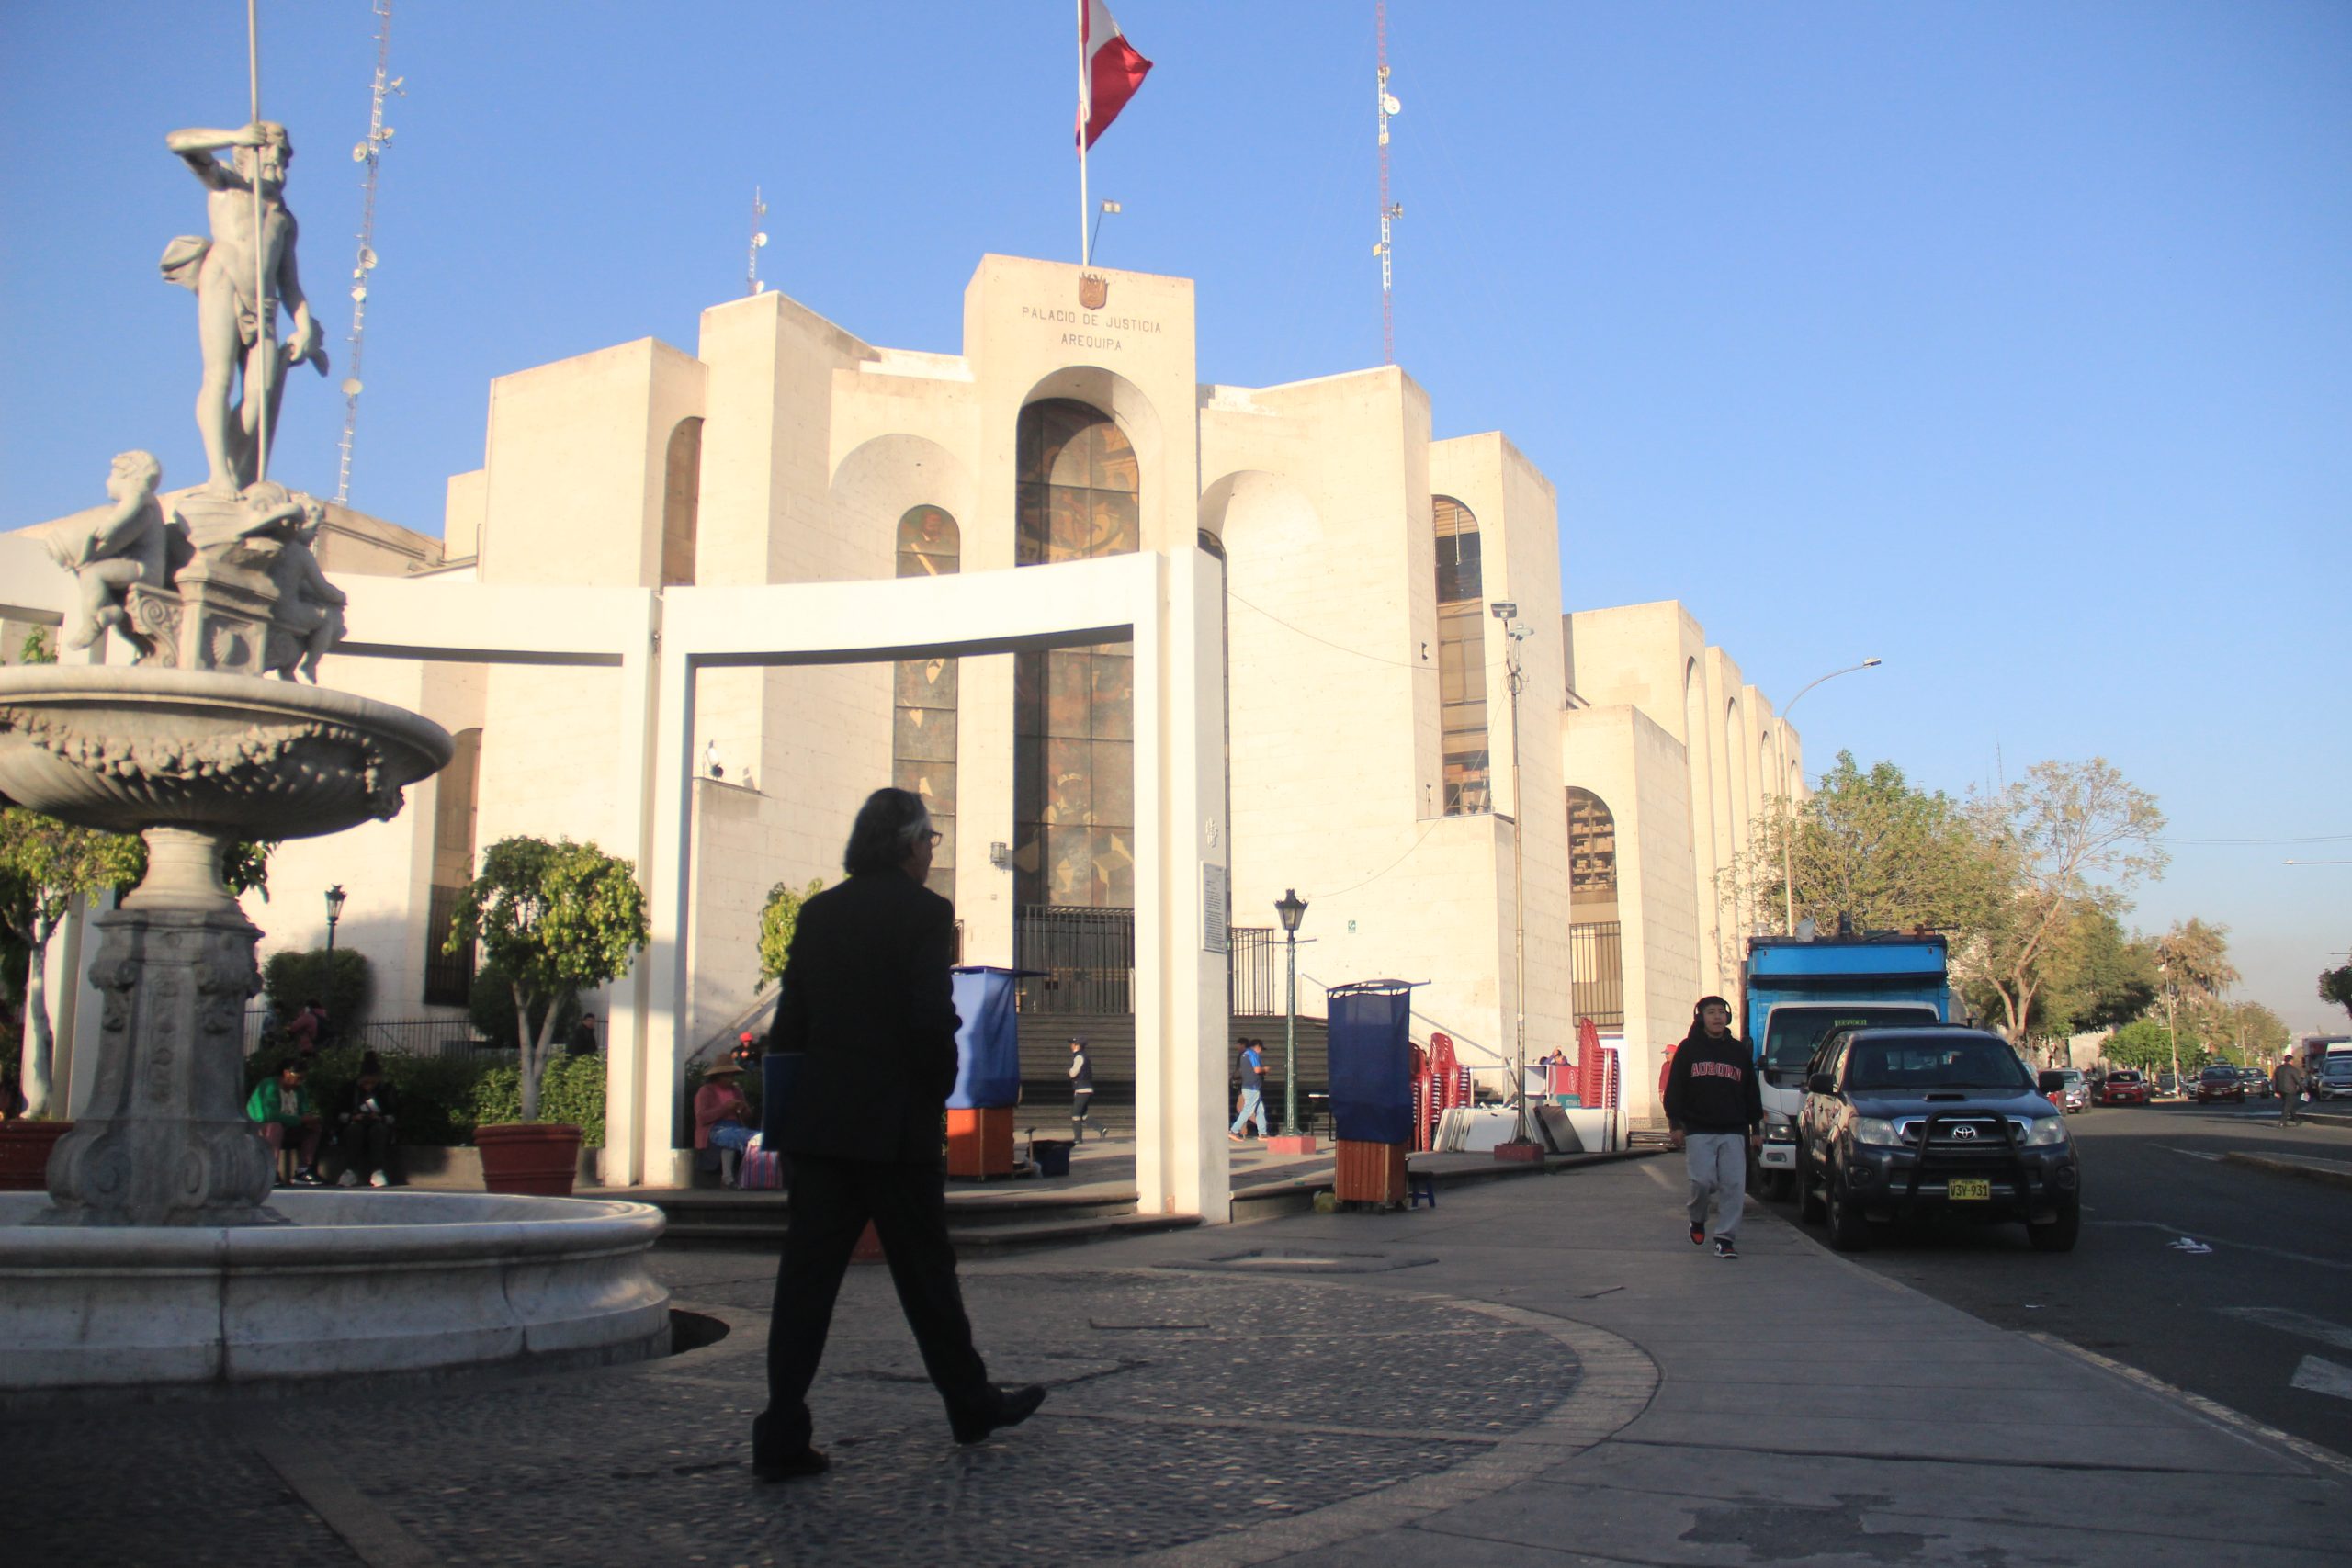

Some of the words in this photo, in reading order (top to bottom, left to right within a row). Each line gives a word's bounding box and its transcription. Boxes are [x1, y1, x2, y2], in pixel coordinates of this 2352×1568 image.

[1022, 306, 1076, 323] PALACIO
[1083, 313, 1098, 326] DE
[1106, 317, 1161, 333] JUSTICIA
[1061, 333, 1122, 351] AREQUIPA
[1691, 1062, 1742, 1081] AUBURN
[1950, 1184, 1988, 1197] V3Y-931
